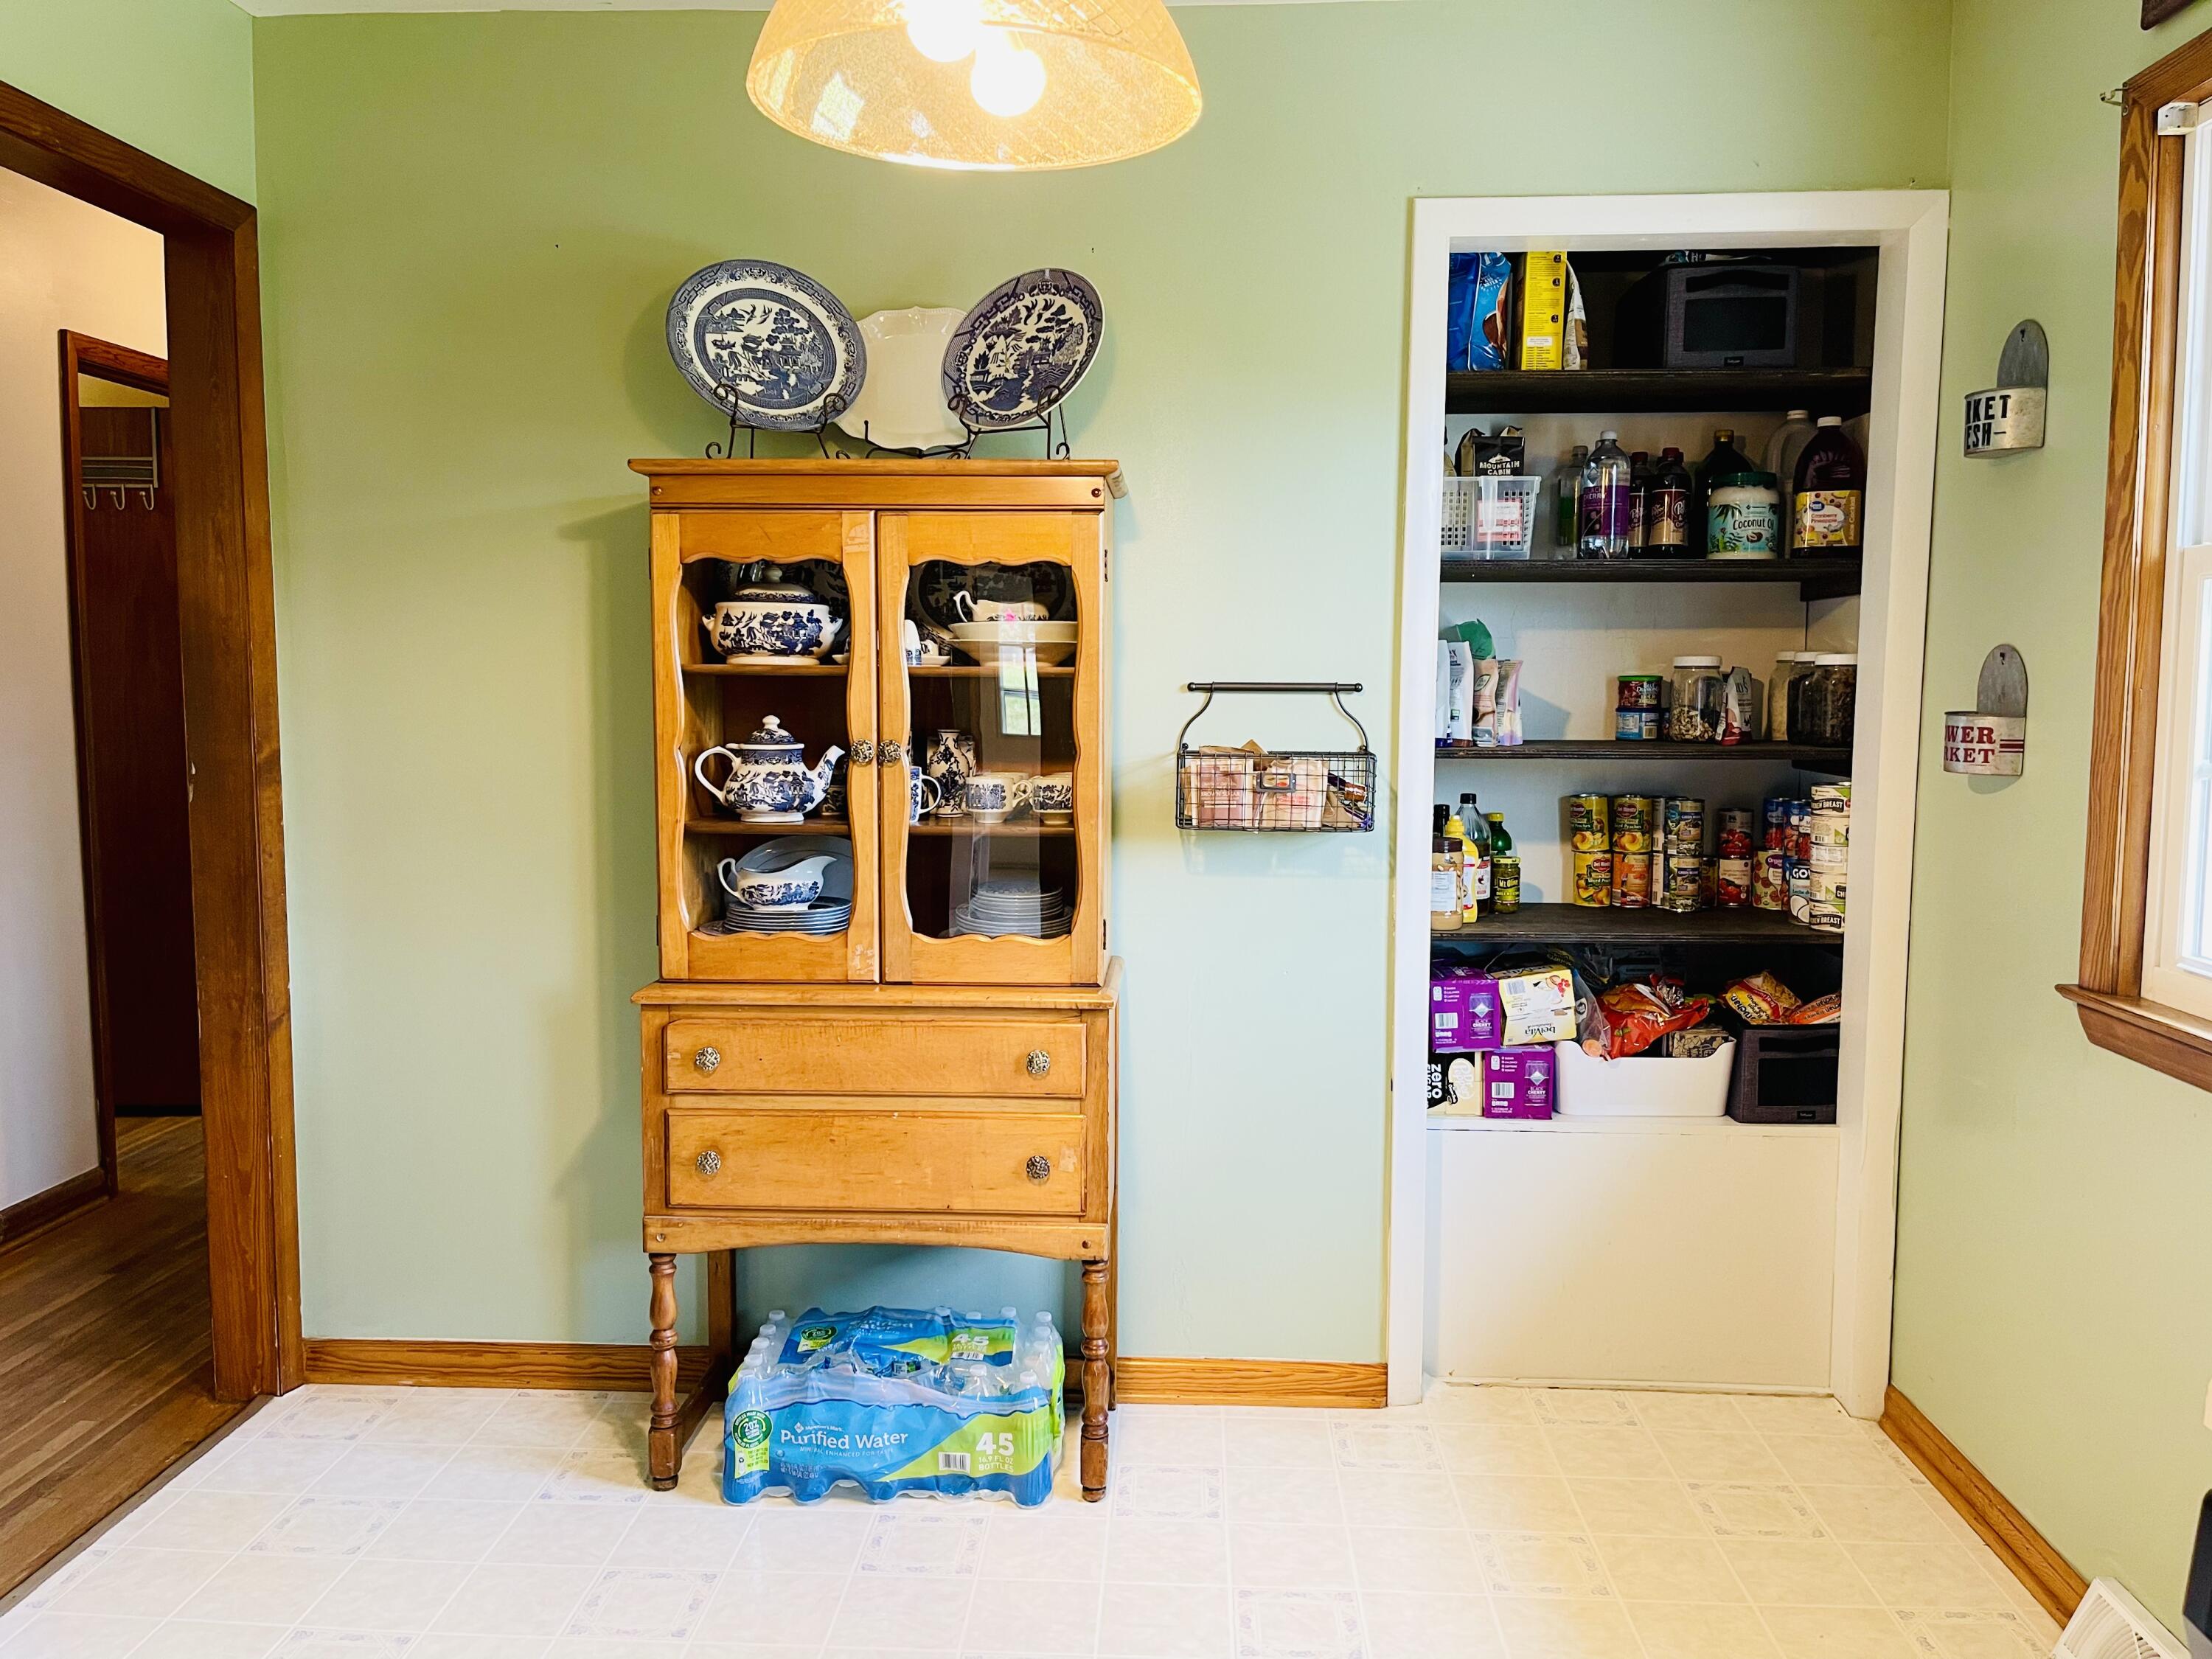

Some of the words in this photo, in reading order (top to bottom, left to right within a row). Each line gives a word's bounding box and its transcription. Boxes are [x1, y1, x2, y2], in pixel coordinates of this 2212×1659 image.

[1479, 460, 1520, 470] MOUNTAIN
[1733, 518, 1765, 530] Coconut
[1945, 725, 1996, 745] WER
[1823, 800, 1843, 809] BREAST
[1792, 869, 1811, 878] GO
[1820, 917, 1840, 925] BREAST
[1525, 1026, 1556, 1038] belVita
[1431, 1063, 1442, 1099] zero
[952, 1333, 990, 1346] 45
[743, 1419, 759, 1432] 20%
[780, 1429, 850, 1450] Purified
[855, 1432, 908, 1450] Water
[975, 1431, 1015, 1456] 45
[825, 1450, 860, 1458] ENHANCED
[1005, 1456, 1014, 1465] OZ
[978, 1461, 1015, 1473] BOTTLES
